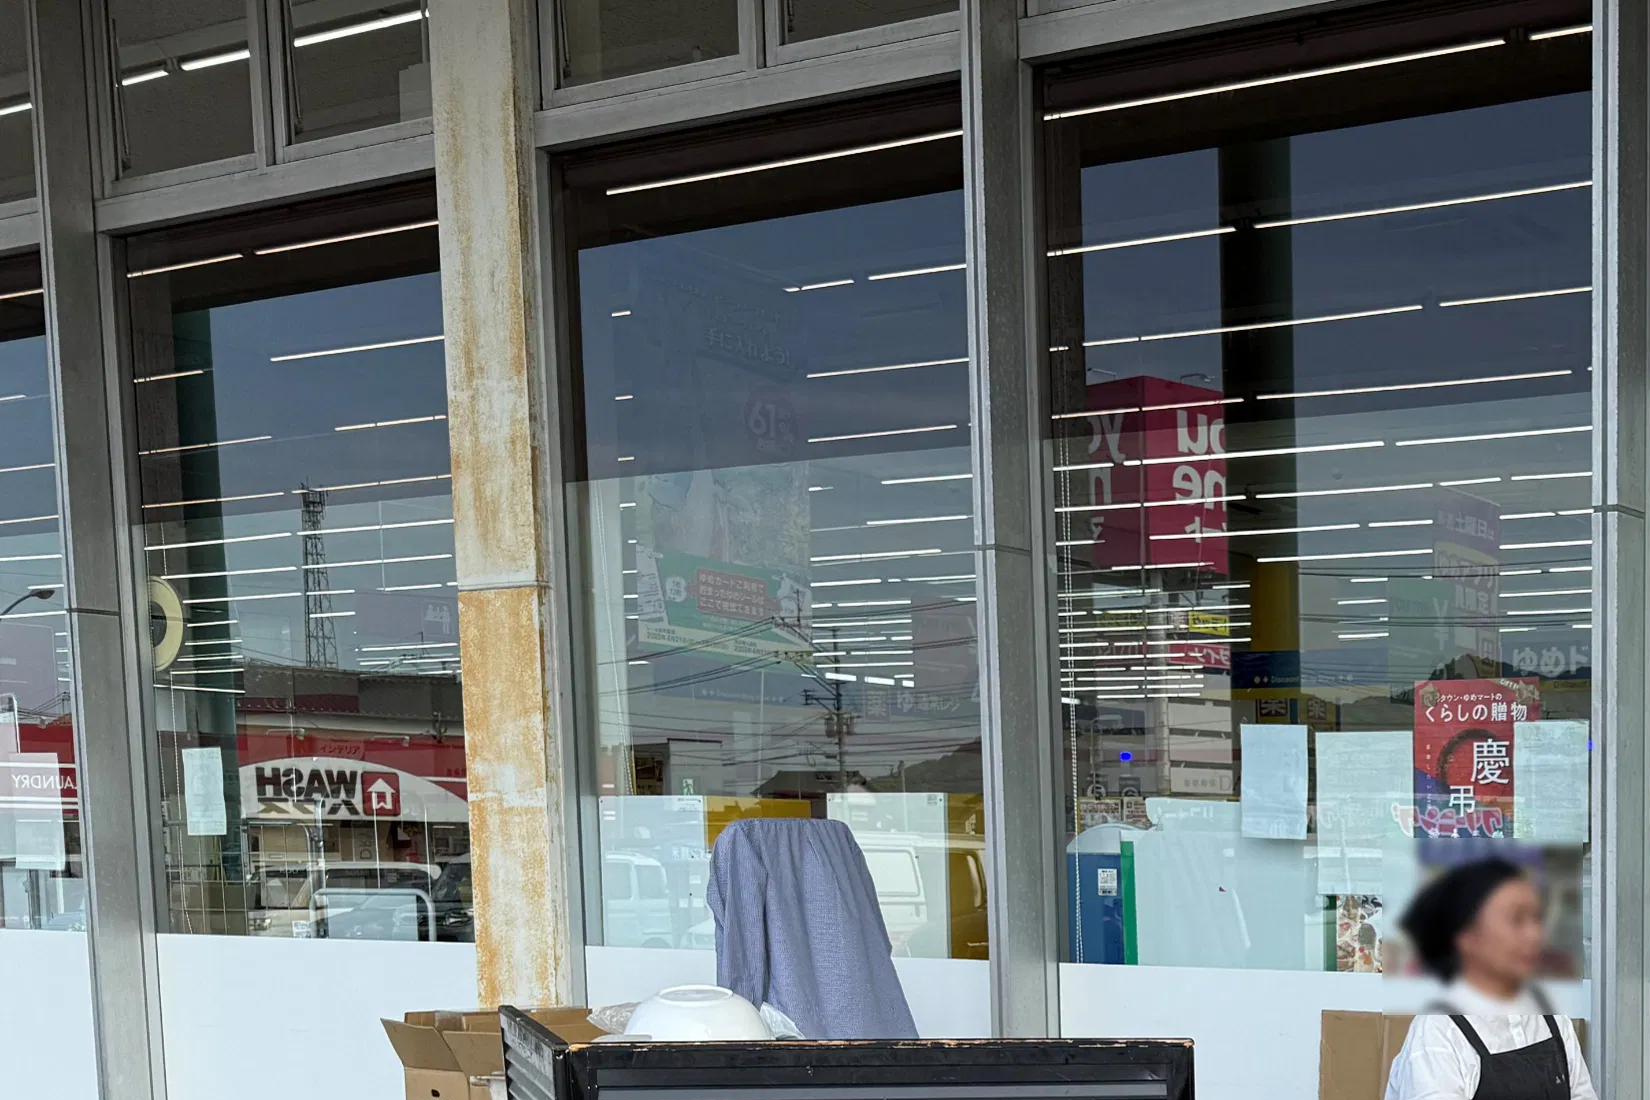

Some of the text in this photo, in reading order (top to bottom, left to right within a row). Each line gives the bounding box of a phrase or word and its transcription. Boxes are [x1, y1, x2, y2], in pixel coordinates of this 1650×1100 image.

[1512, 645, 1590, 677] ゆめド
[1425, 701, 1528, 722] くらしの贈物
[1470, 738, 1510, 784] 慶
[1449, 785, 1476, 817] 弔
